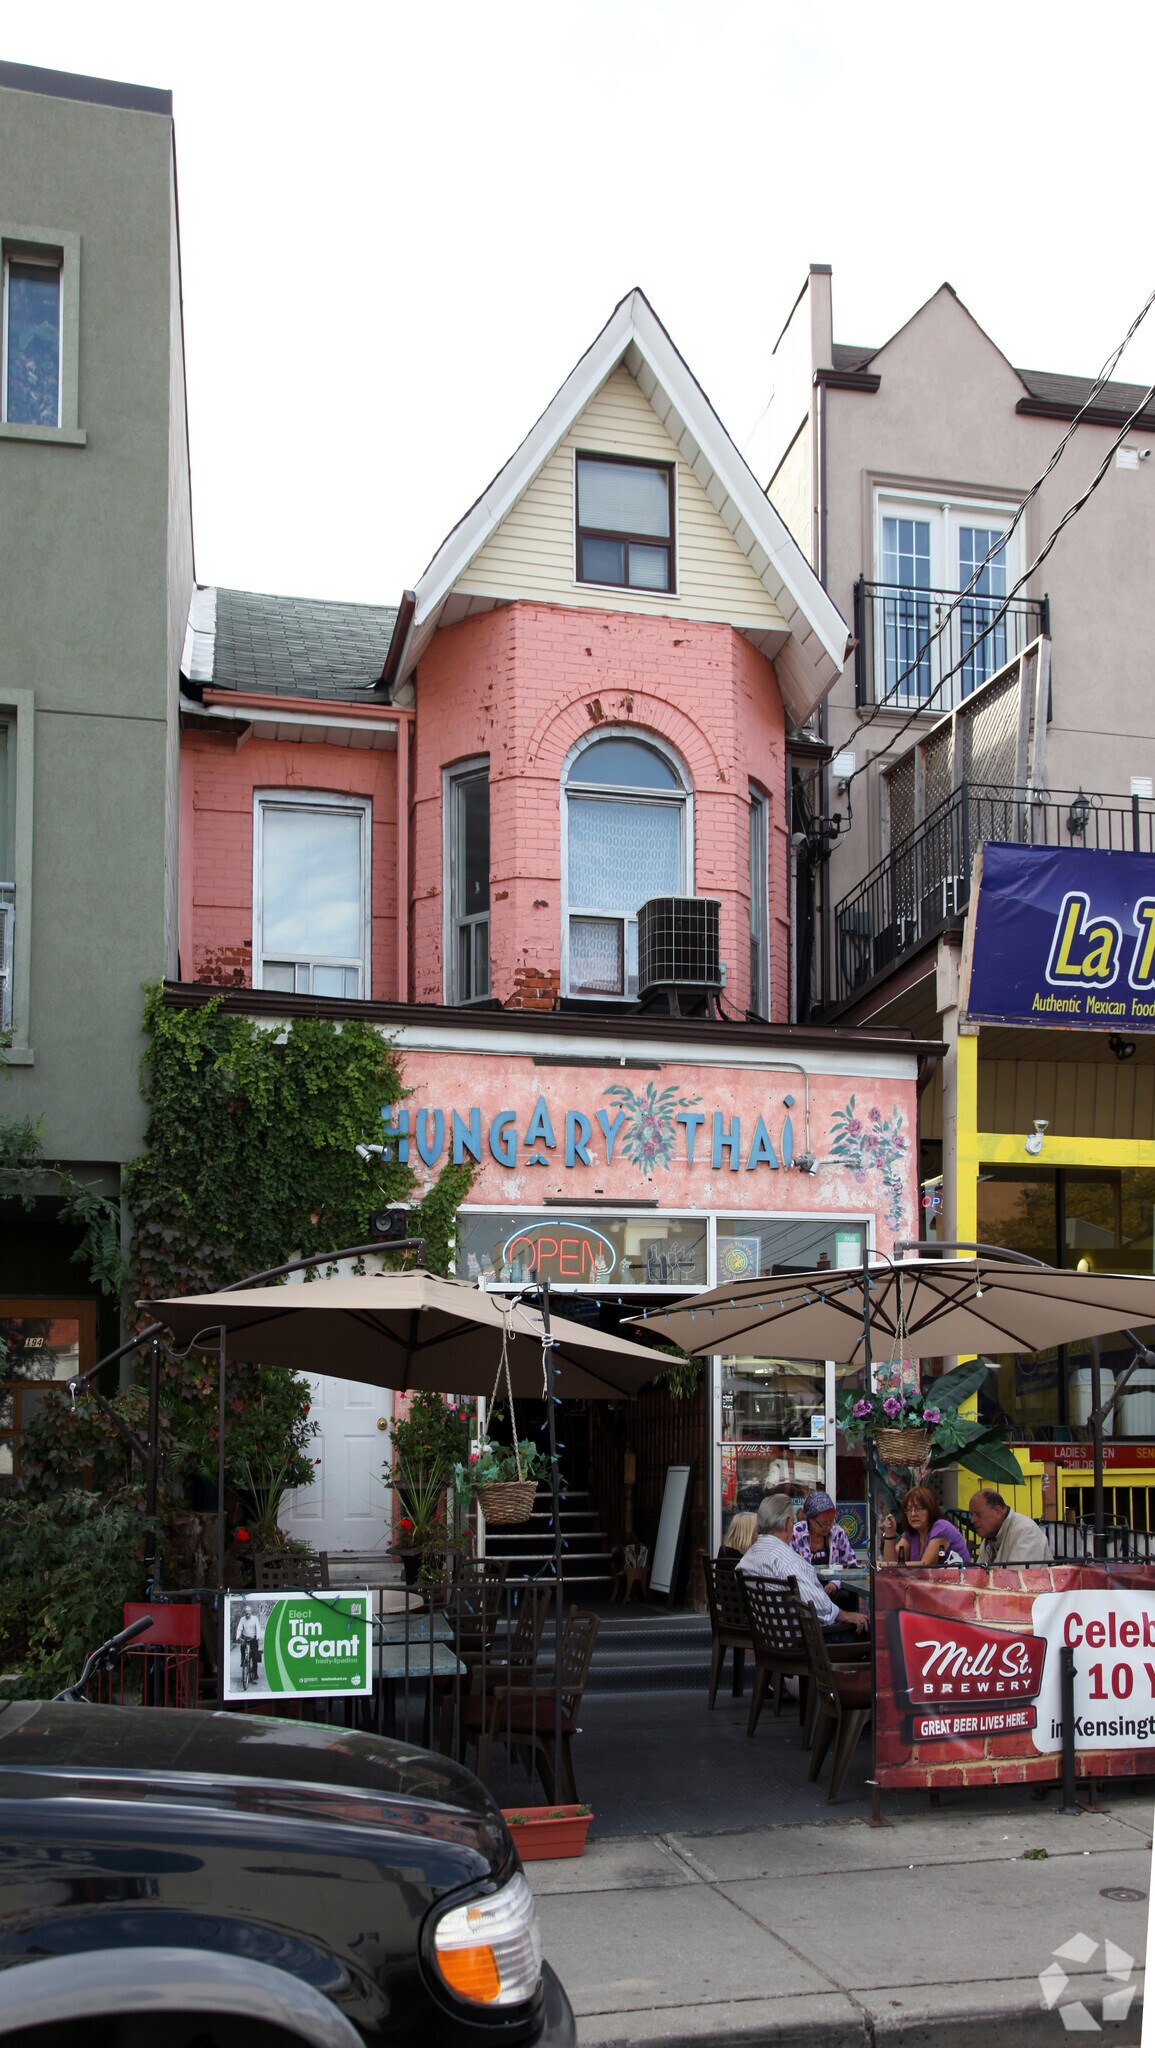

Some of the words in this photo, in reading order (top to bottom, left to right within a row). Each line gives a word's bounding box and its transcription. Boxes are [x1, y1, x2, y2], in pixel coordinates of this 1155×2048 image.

[1051, 898, 1117, 982] La
[1031, 992, 1082, 1014] Authentic
[1085, 995, 1127, 1016] Mexican
[1131, 997, 1155, 1017] Food
[380, 1094, 627, 1169] HUNGARY
[509, 1235, 604, 1276] OPEN
[25, 1338, 43, 1348] 194
[1054, 1447, 1087, 1459] LADIES
[1063, 1459, 1108, 1470] CHILDRN
[288, 1609, 312, 1619] Elect
[288, 1619, 323, 1636] Tim
[287, 1635, 360, 1659] Grant
[915, 1640, 999, 1678] Mill
[998, 1642, 1033, 1678] St.
[923, 1679, 1032, 1695] BREWERY
[1088, 1662, 1134, 1700] 10
[920, 1720, 951, 1737] GREAT
[953, 1717, 978, 1734] BEER
[980, 1714, 1005, 1732] LIVES
[1051, 1718, 1063, 1739] in
